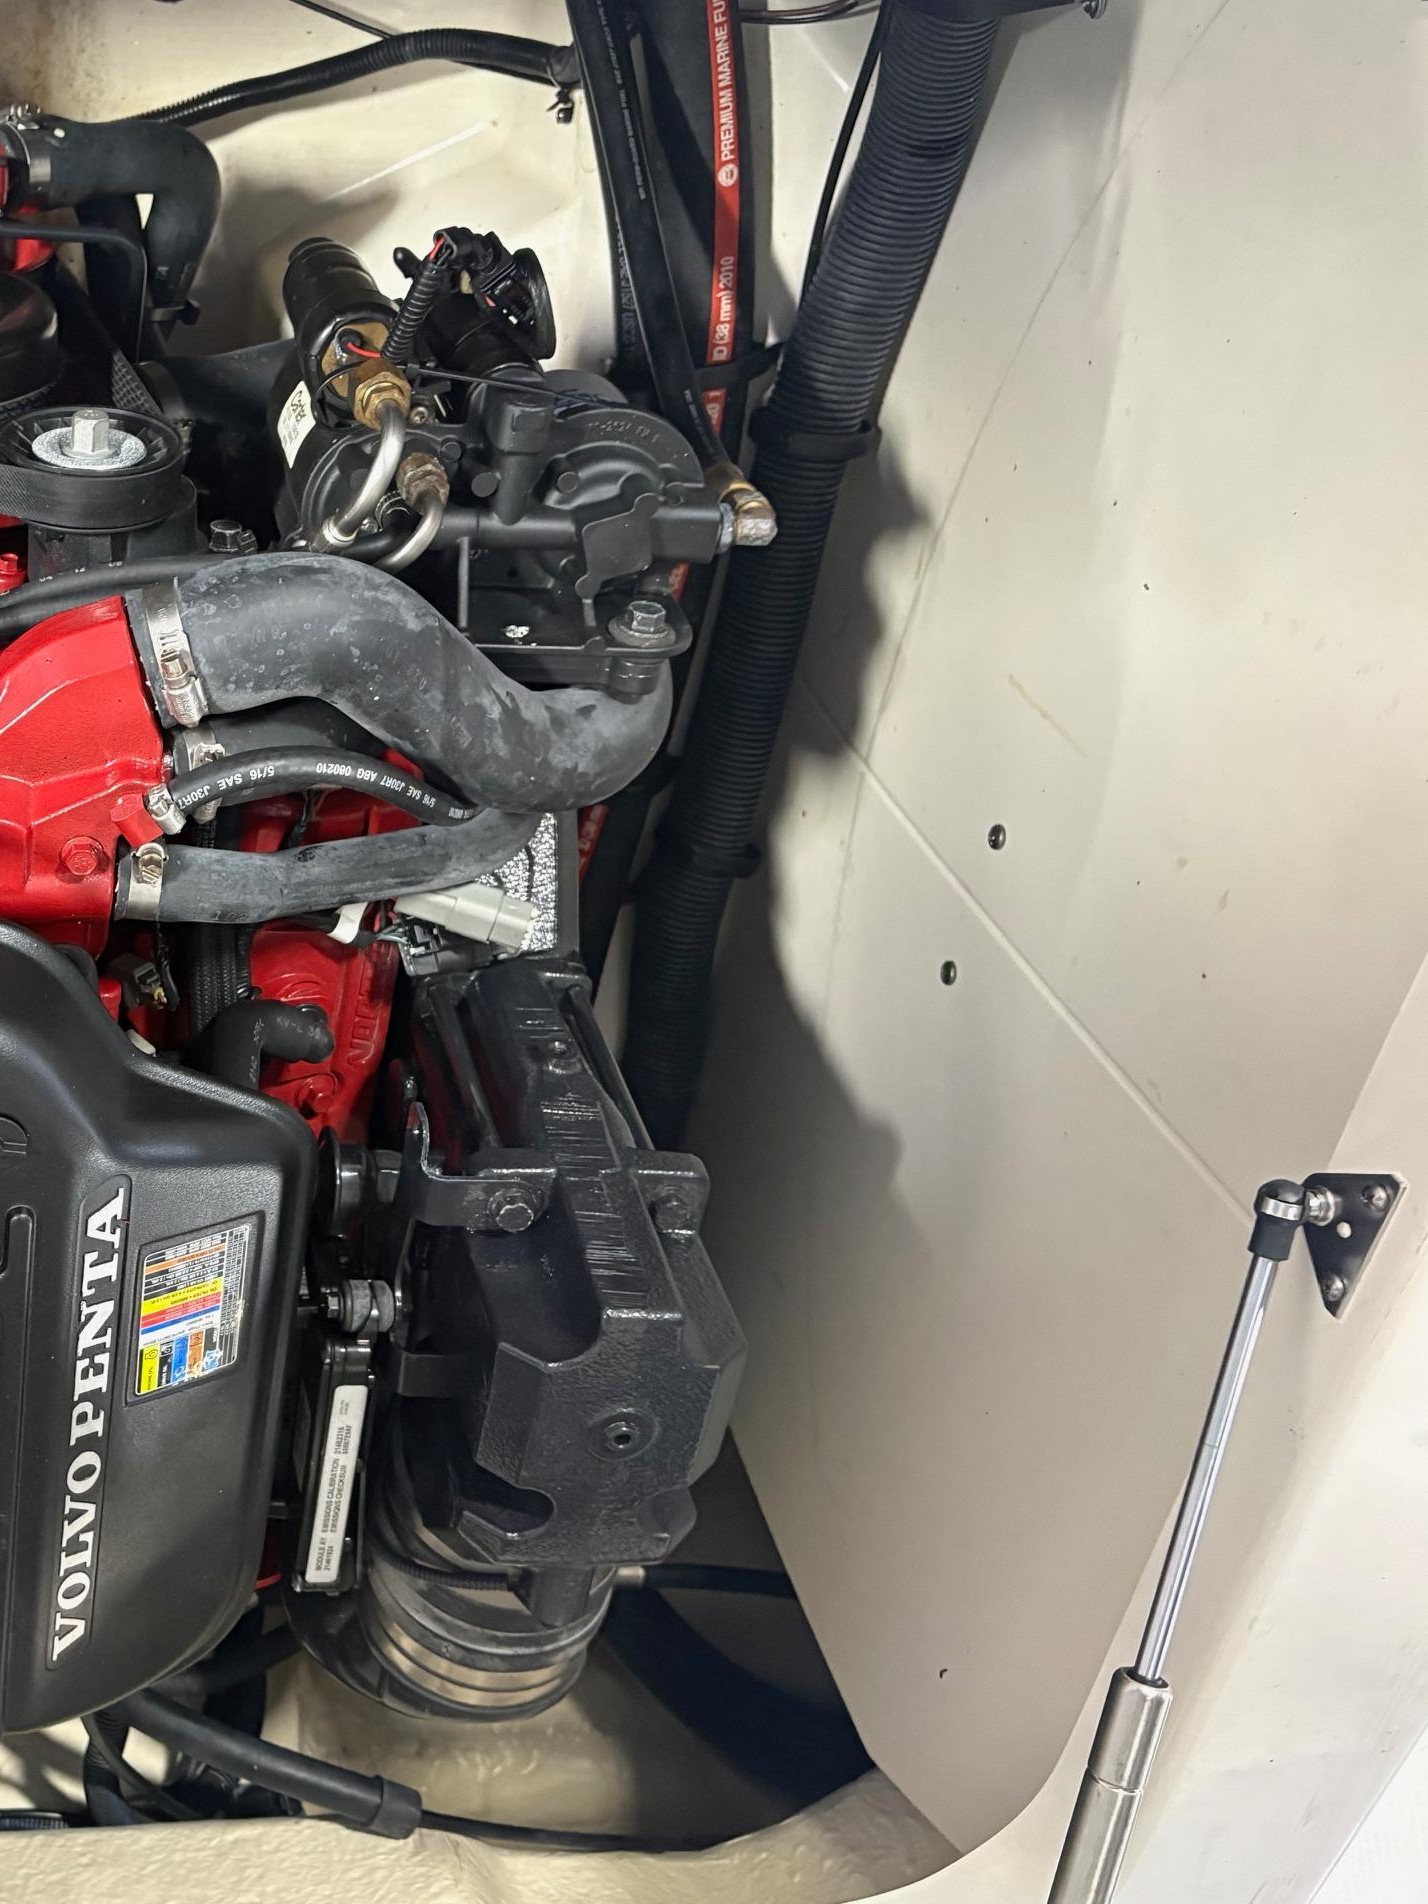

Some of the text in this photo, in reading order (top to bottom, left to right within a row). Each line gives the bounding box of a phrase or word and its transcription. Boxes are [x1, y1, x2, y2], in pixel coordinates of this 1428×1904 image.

[713, 0, 734, 161] PREMIUM MARINE FU
[719, 256, 734, 289] 2010
[716, 291, 733, 321] mm)
[218, 774, 242, 790] SAE
[250, 765, 275, 781] 5/16
[316, 763, 351, 777] 080210
[356, 767, 378, 782] ABG
[381, 774, 406, 792] J30R7
[177, 787, 210, 810] J30R7
[407, 785, 422, 800] SAE
[52, 1187, 124, 1662] VOLVO PENTA
[326, 1458, 340, 1500] CALIBRATION
[335, 1464, 347, 1499] CHECKSUM
[322, 1501, 333, 1533] EMISSIONS
[330, 1501, 341, 1533] EMISSIONS
[316, 1543, 325, 1571] MODULE
